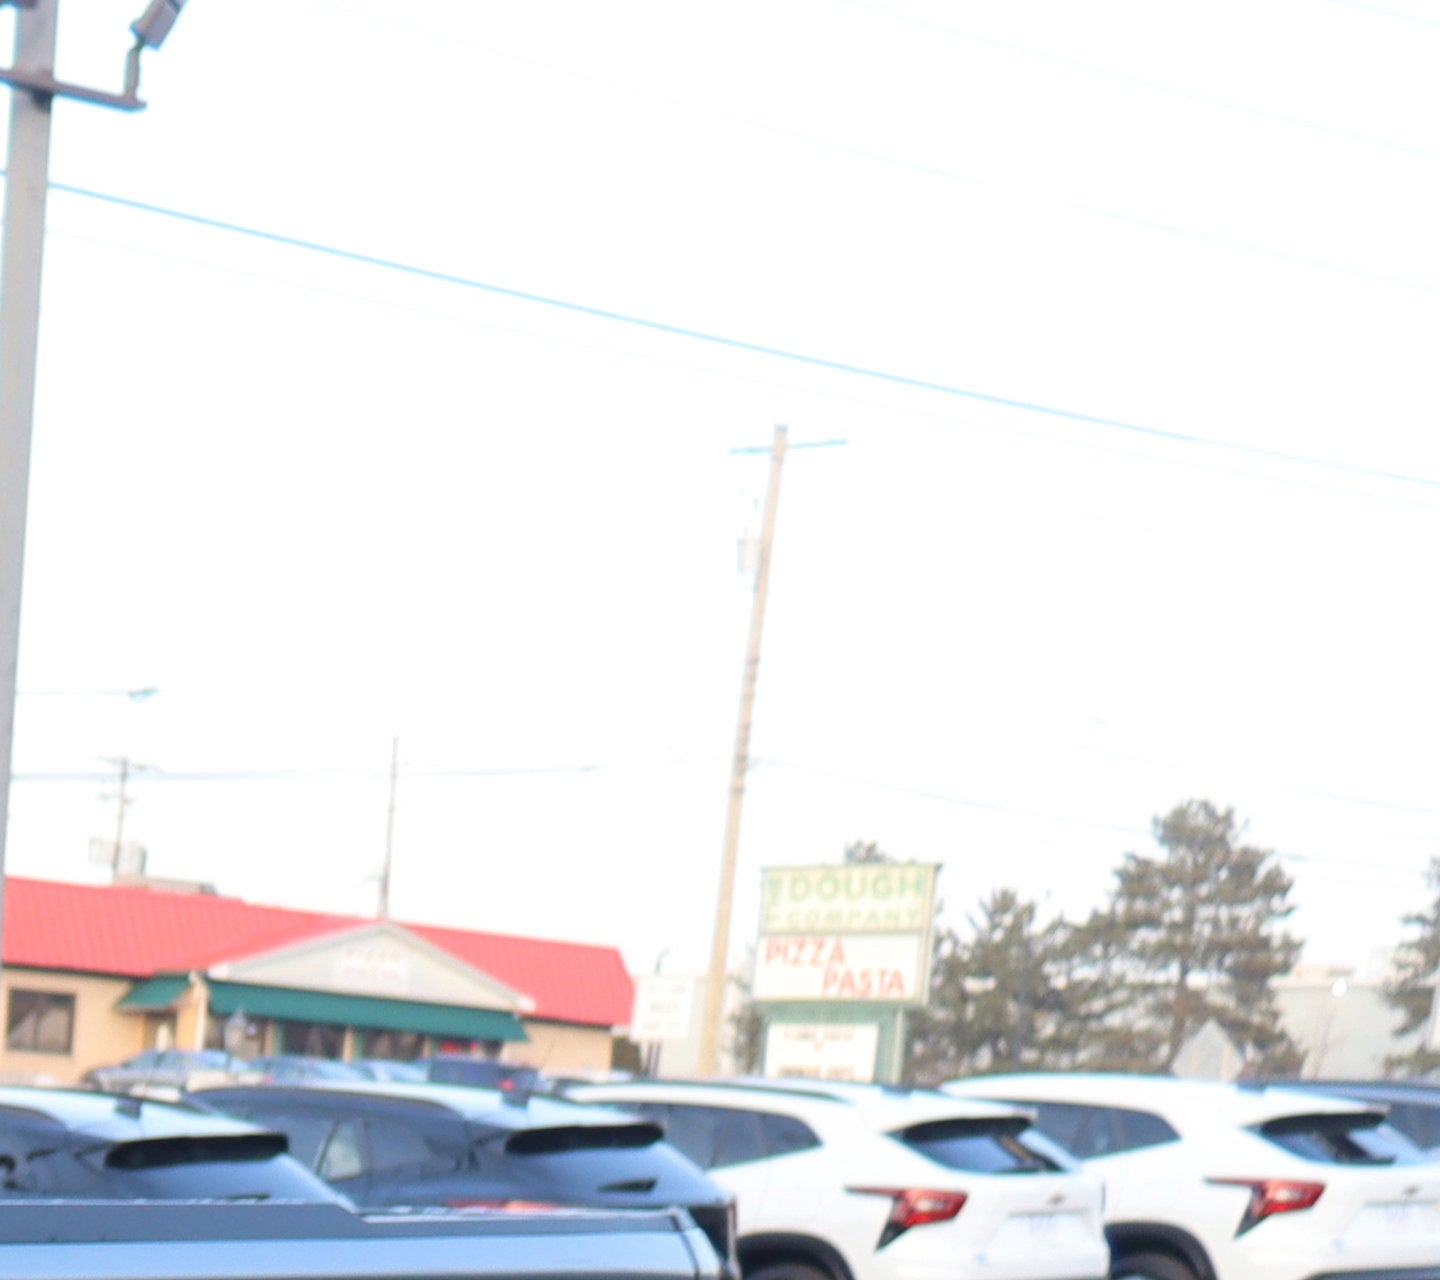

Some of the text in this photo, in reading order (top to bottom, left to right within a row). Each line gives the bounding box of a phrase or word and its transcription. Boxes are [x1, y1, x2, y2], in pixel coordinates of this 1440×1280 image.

[790, 872, 926, 903] DOUGH
[787, 907, 921, 926] COMPANY
[765, 936, 846, 967] PIZZA
[822, 967, 906, 999] PASTA
